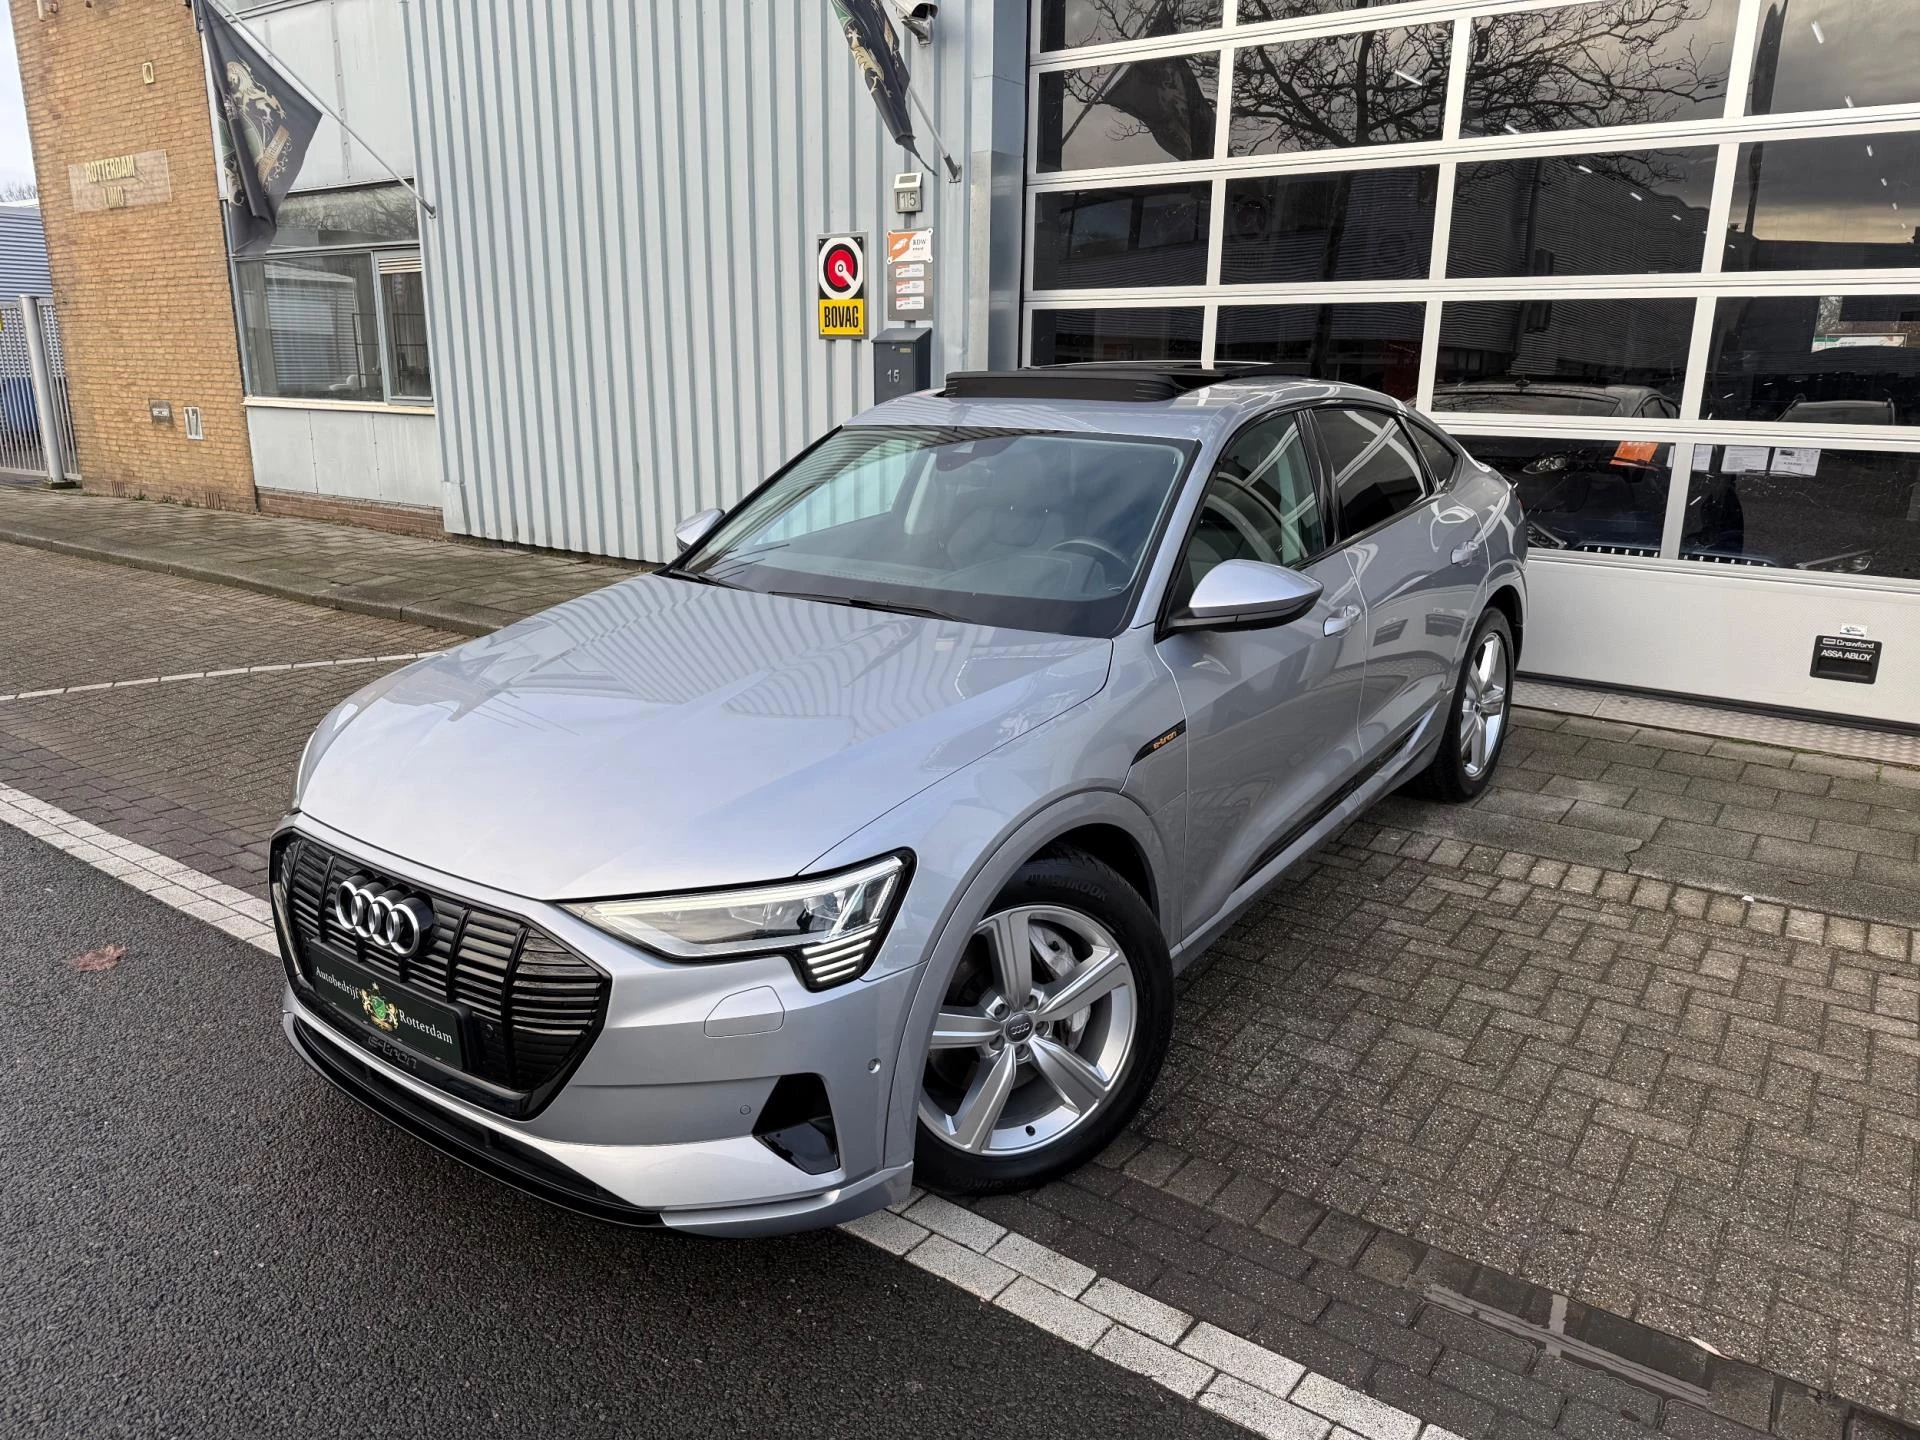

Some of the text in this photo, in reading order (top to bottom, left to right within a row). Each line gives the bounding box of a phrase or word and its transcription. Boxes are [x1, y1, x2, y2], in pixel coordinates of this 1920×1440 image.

[85, 154, 136, 184] ROTTERDAM
[900, 192, 917, 209] 15
[912, 238, 927, 246] RDW
[823, 305, 860, 329] BOVAG
[886, 369, 900, 384] 15
[185, 408, 199, 436] 17
[1836, 639, 1875, 649] Crawford
[1820, 649, 1873, 661] ASSA ABLOY
[1152, 730, 1178, 750] e-tron
[315, 965, 454, 1045] Autobedrijf Rotterdam
[367, 1034, 418, 1070] e-tron
